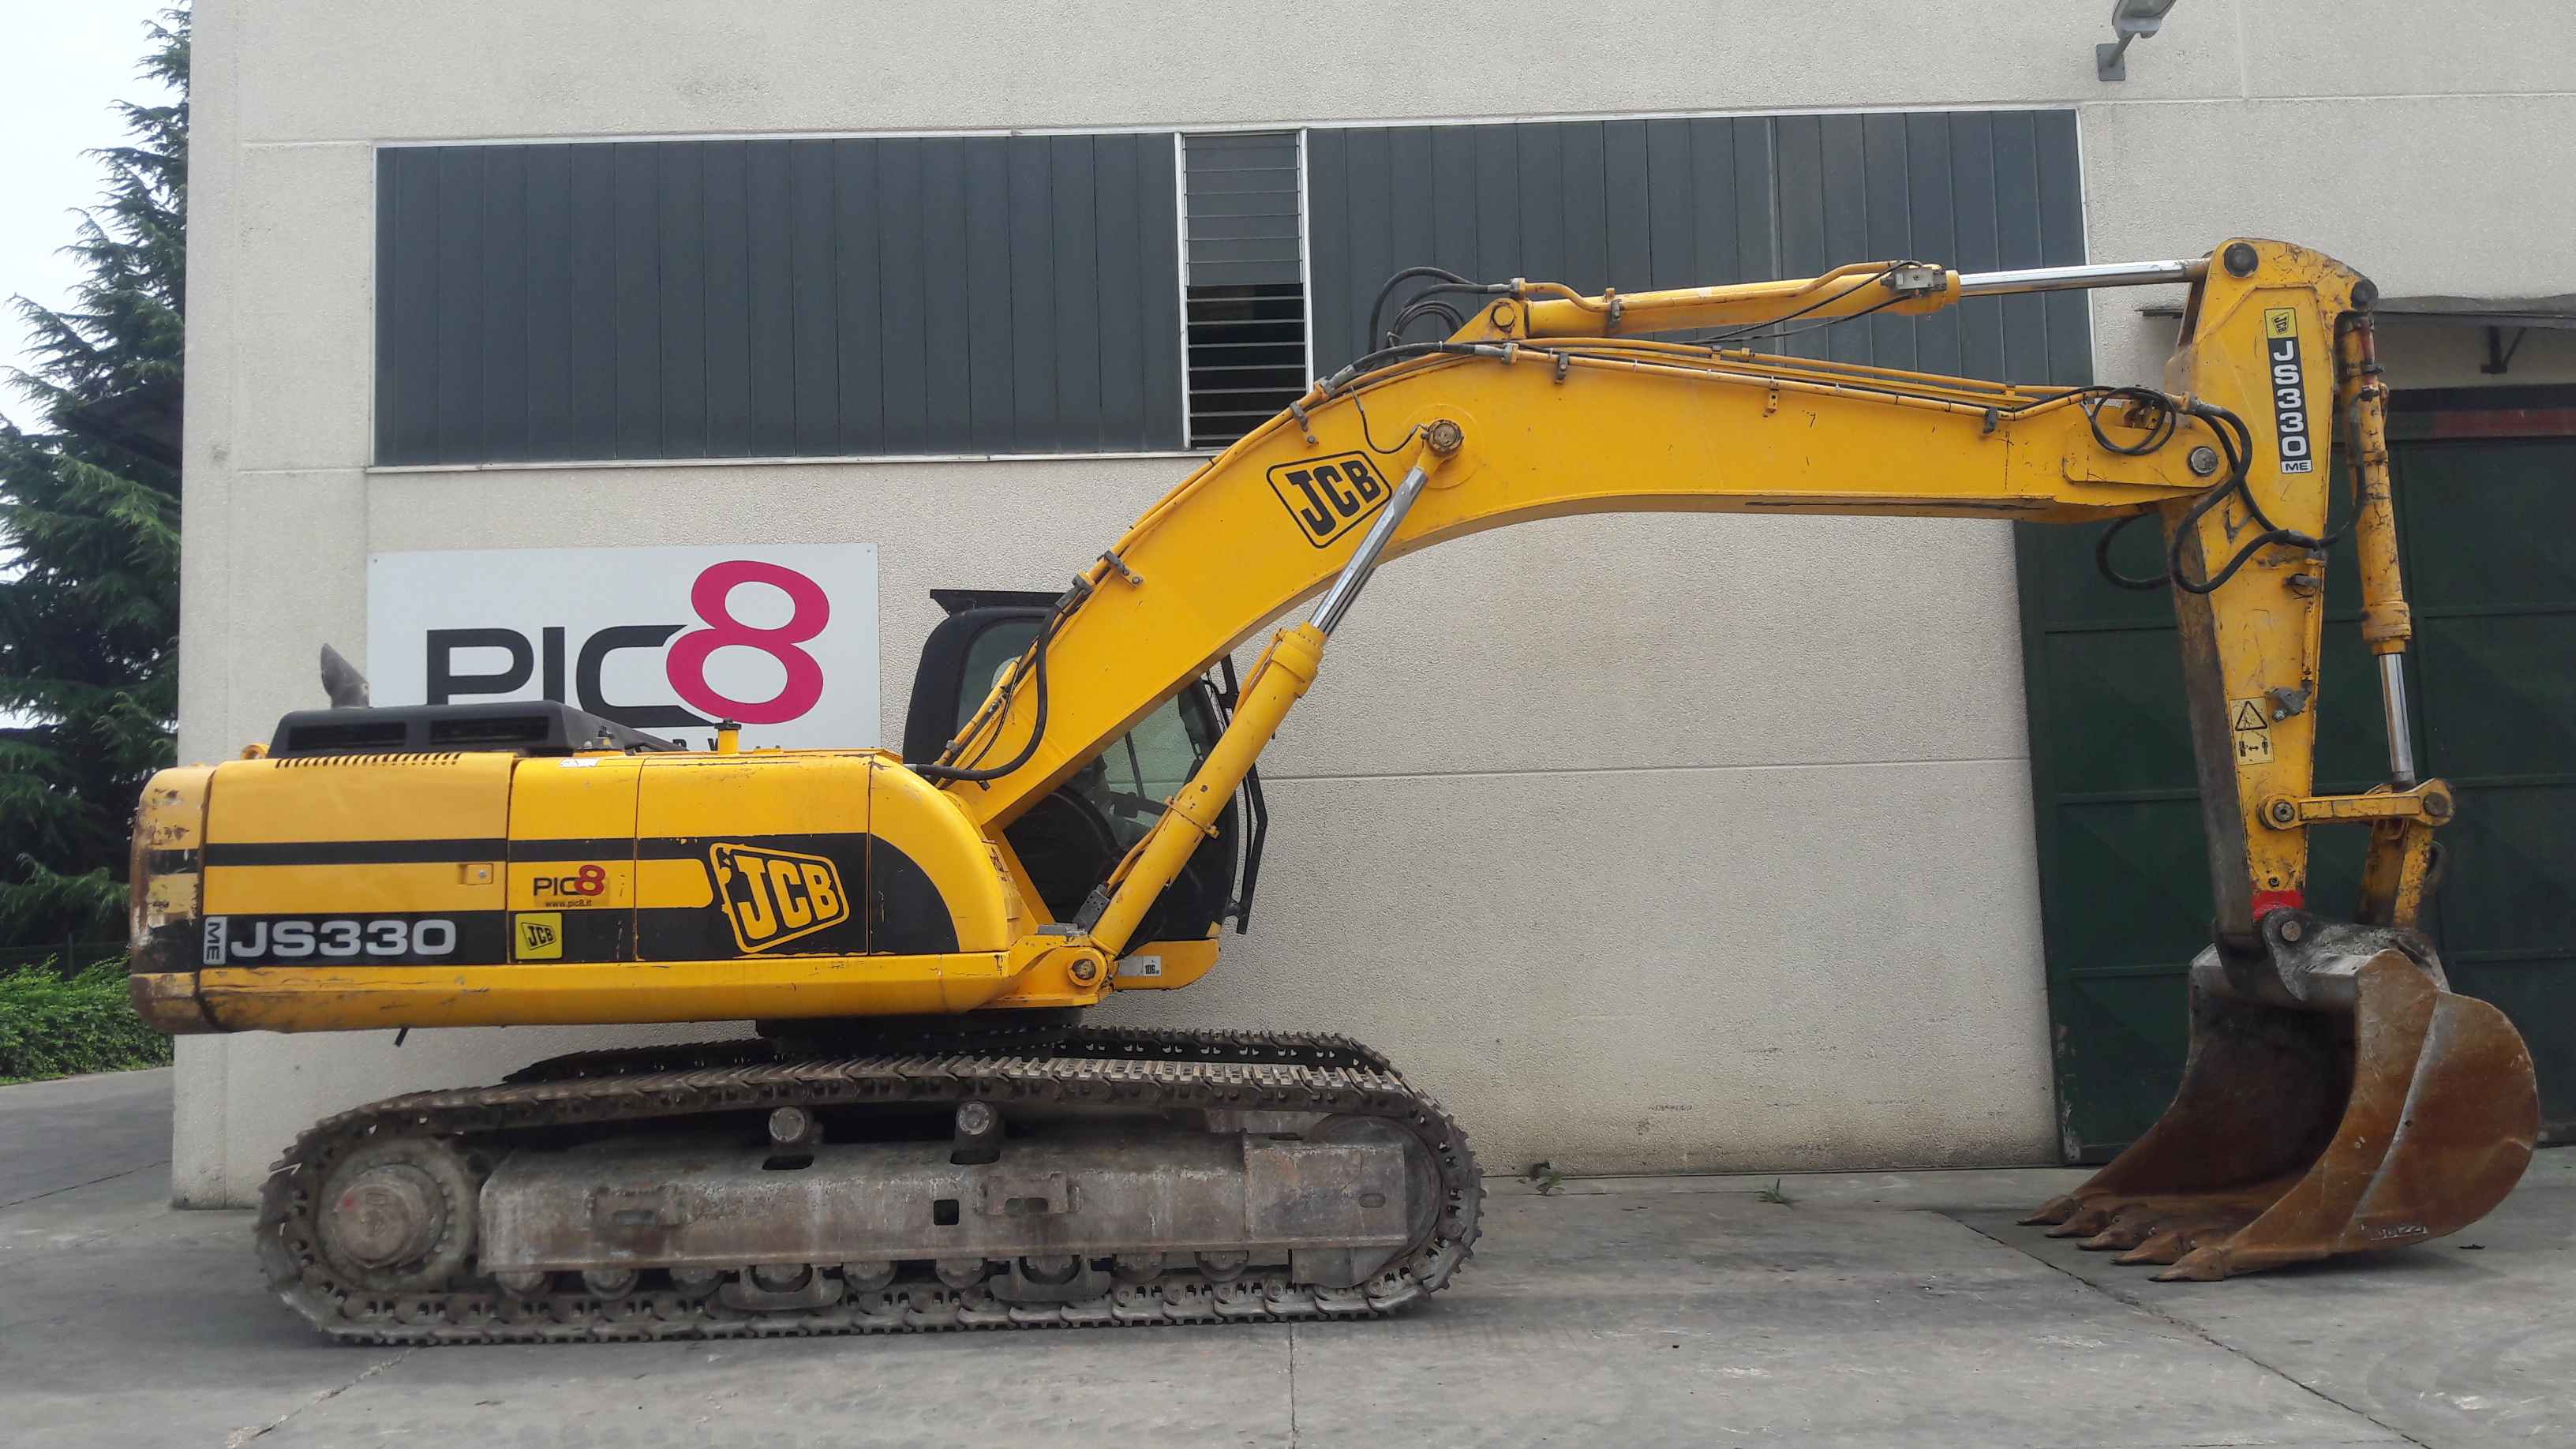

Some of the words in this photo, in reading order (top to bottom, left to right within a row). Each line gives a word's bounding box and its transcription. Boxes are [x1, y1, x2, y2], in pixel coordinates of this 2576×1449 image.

[2273, 316, 2287, 335] JCB
[2273, 340, 2307, 457] JS330
[2285, 462, 2309, 471] ME
[1285, 460, 1381, 536] JCB
[426, 560, 829, 728] PIC8
[534, 864, 606, 896] PIC8
[733, 853, 840, 941] JCB
[545, 898, 593, 908] www.pic8.it
[206, 921, 221, 961] ME
[230, 919, 457, 958] JS330
[527, 925, 554, 947] JCB
